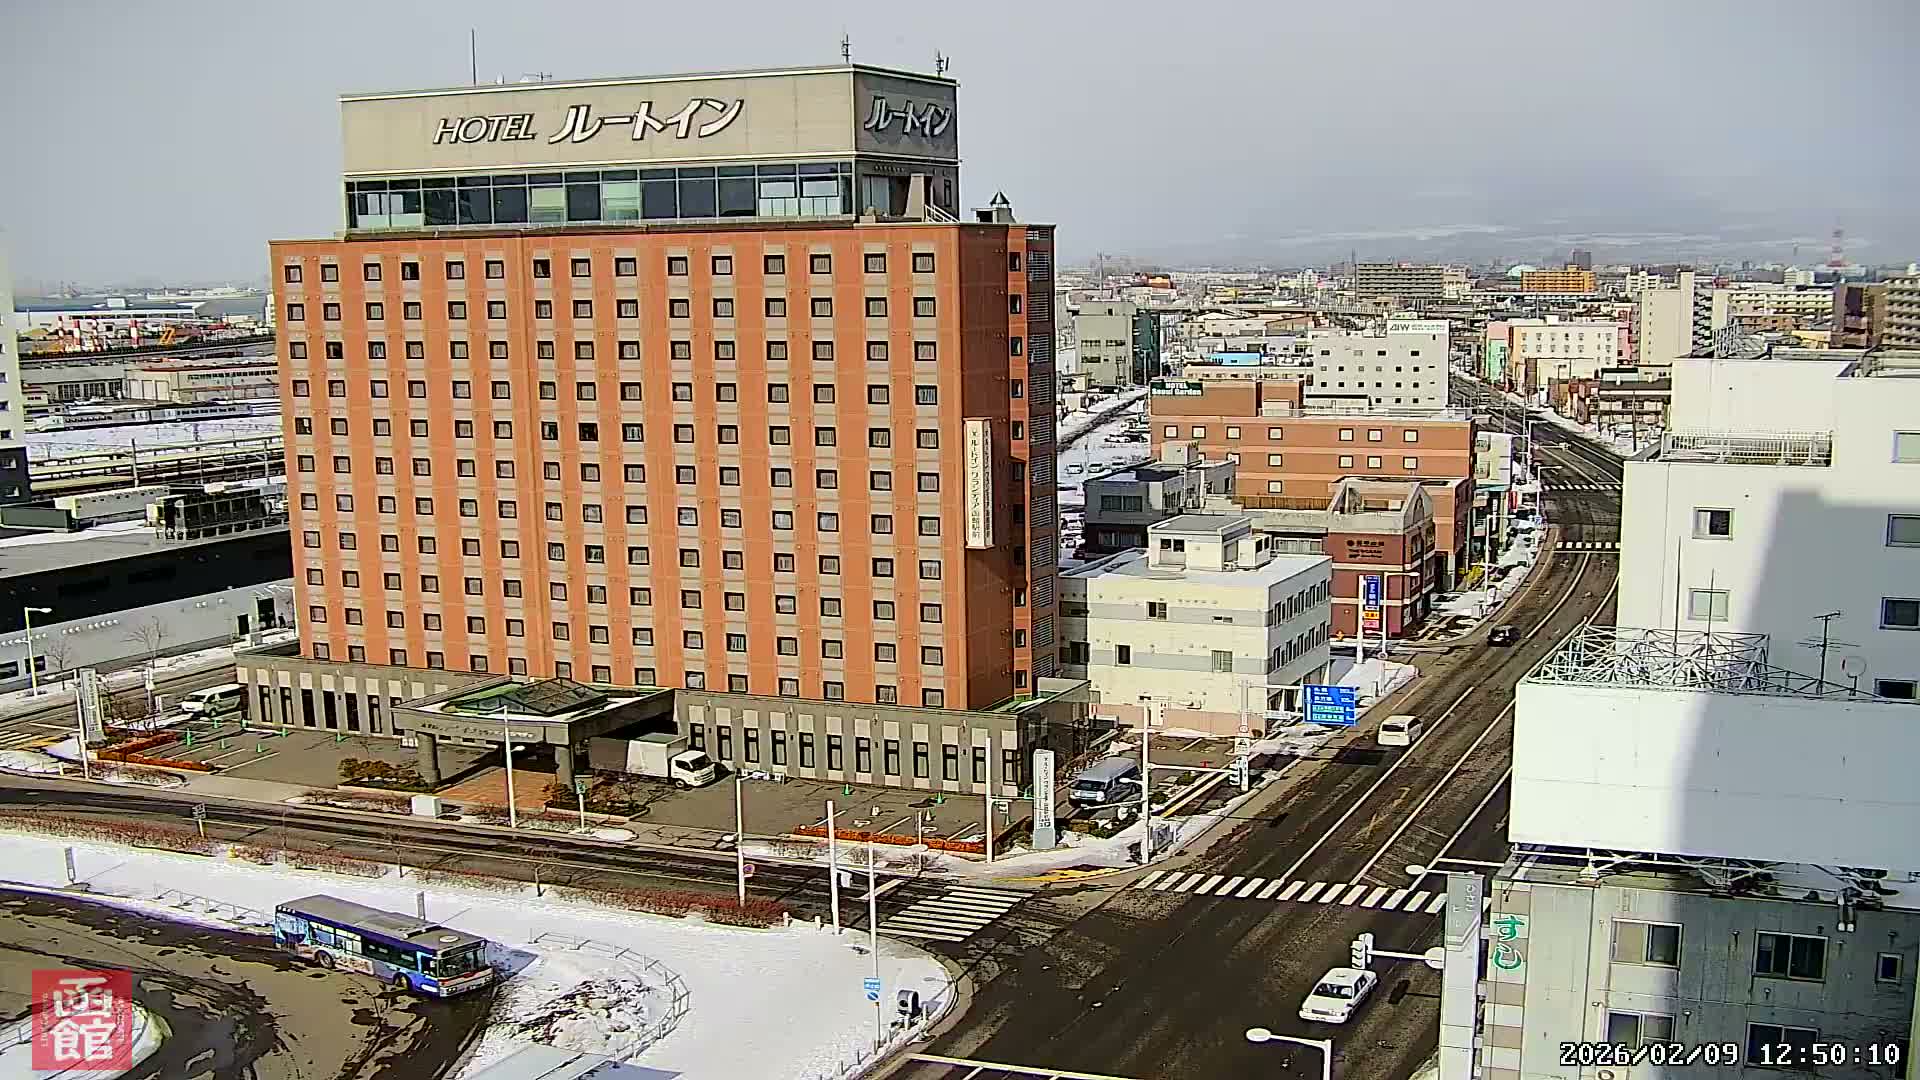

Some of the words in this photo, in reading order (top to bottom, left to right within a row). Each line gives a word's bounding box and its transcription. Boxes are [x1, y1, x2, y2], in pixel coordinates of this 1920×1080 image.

[433, 113, 537, 144] HOTEL
[548, 98, 744, 144] ルートイン
[863, 95, 952, 137] ルートイン
[1493, 915, 1526, 970] すし
